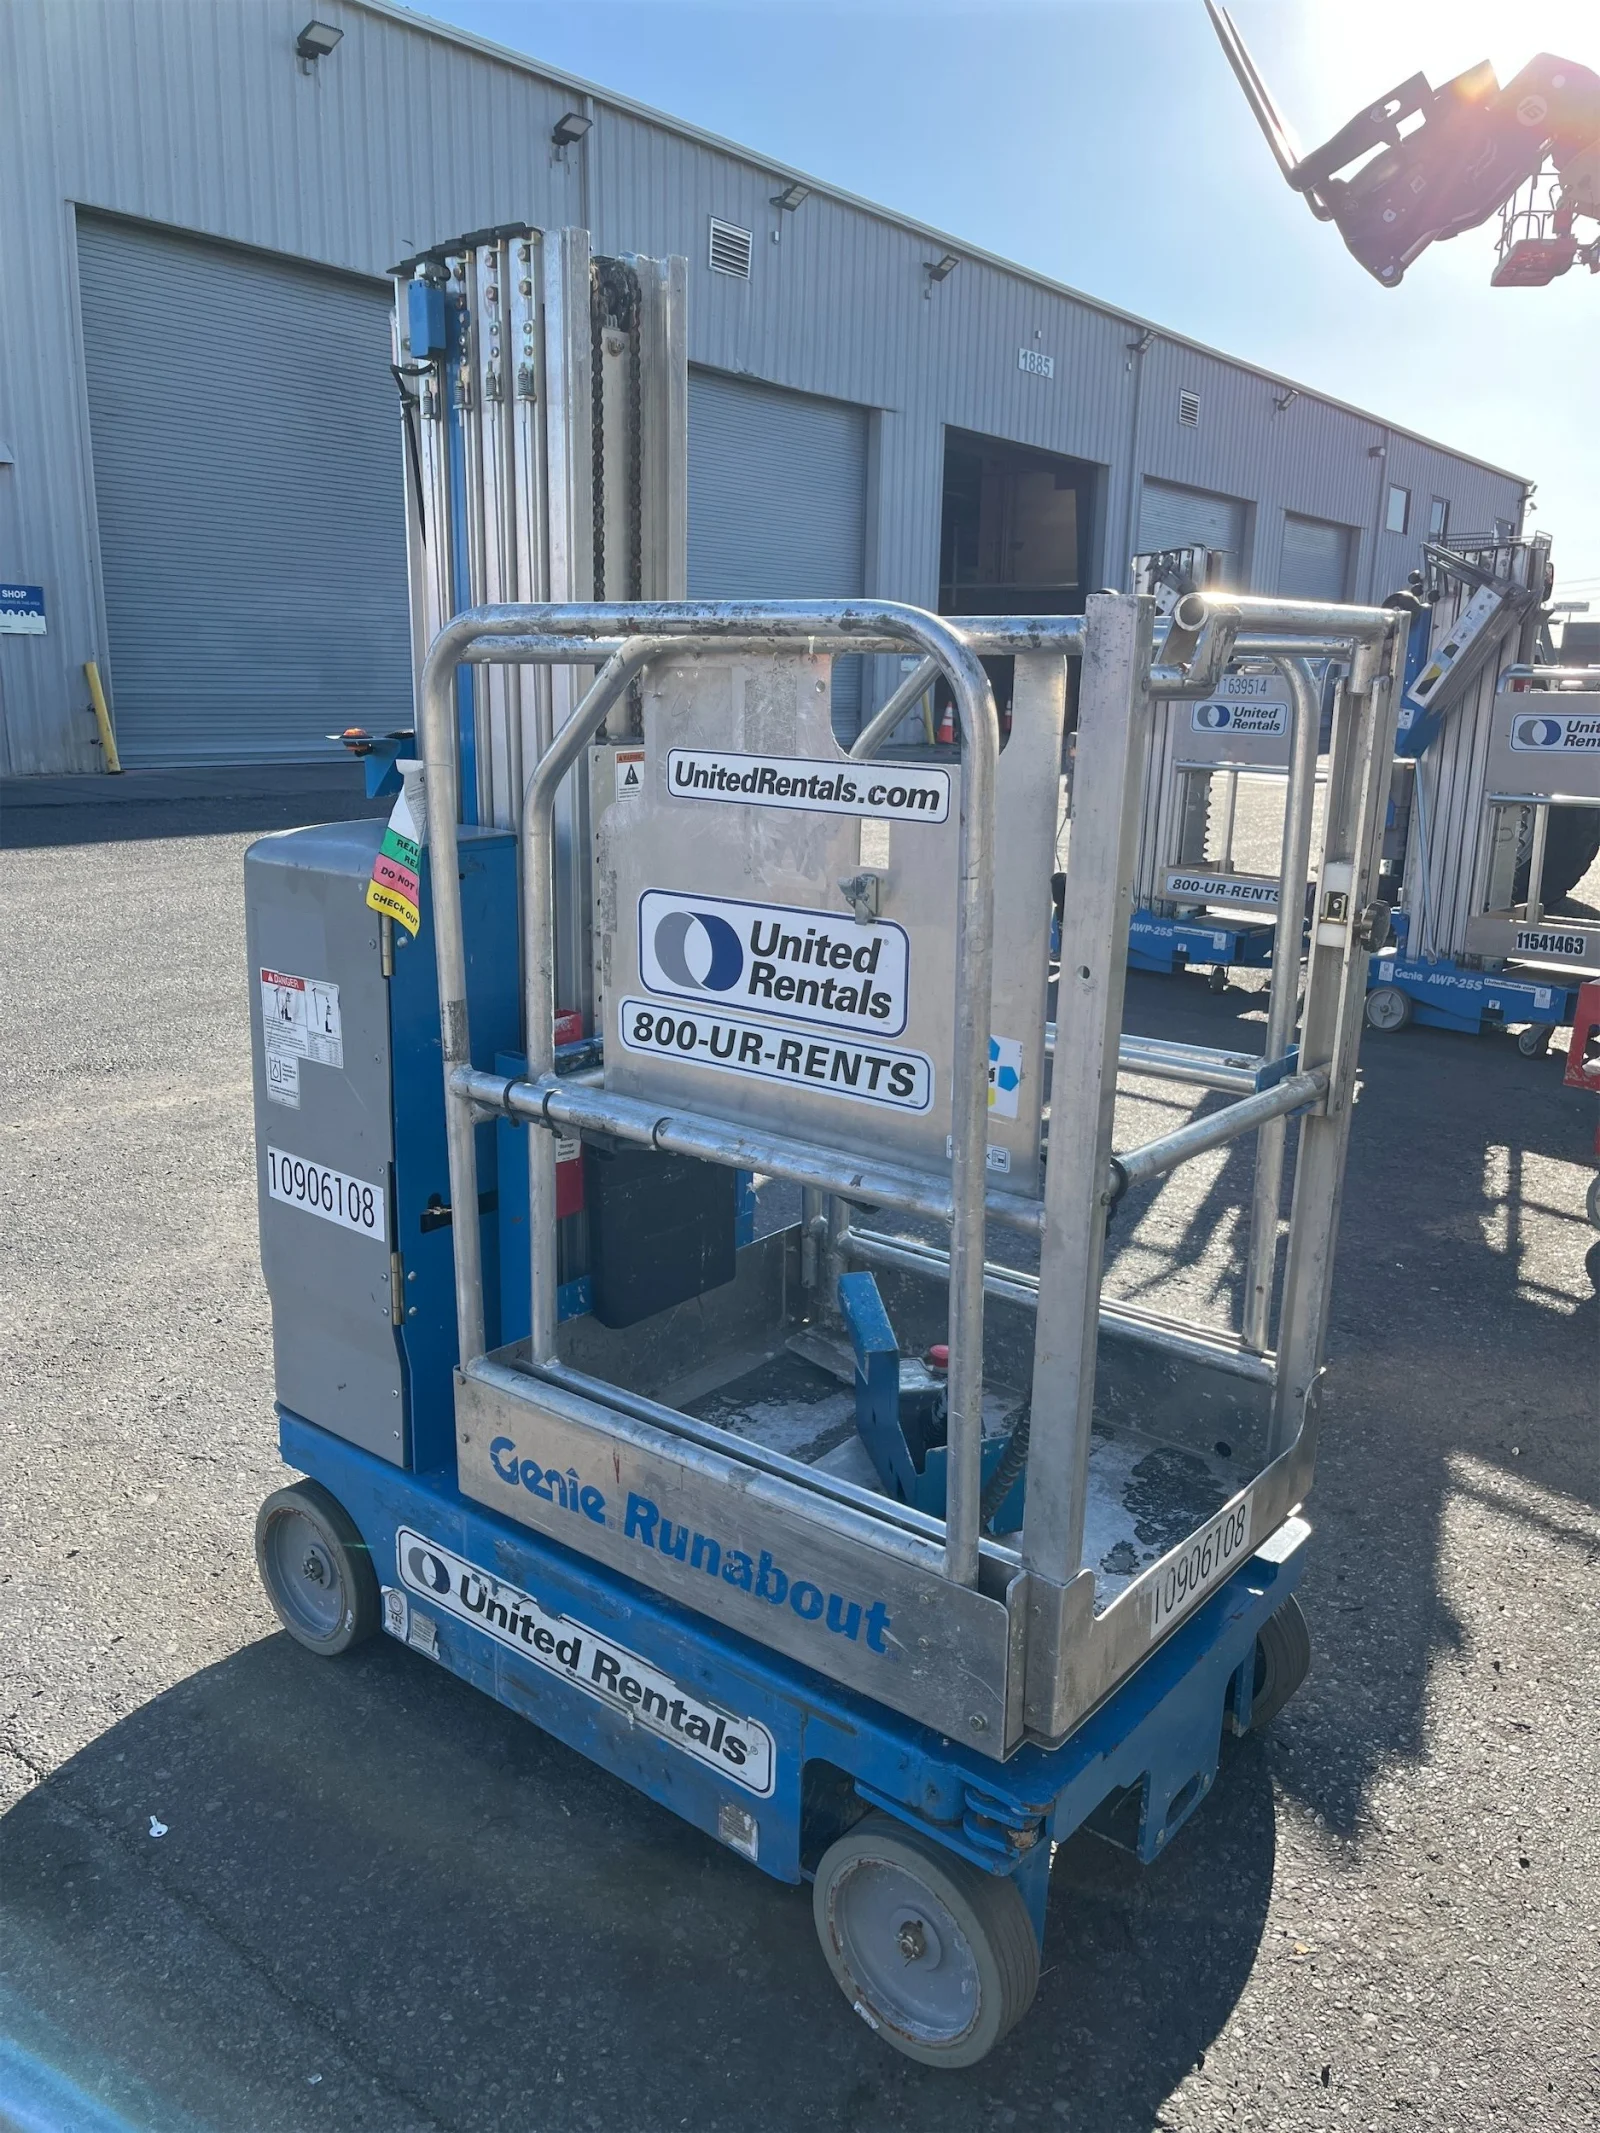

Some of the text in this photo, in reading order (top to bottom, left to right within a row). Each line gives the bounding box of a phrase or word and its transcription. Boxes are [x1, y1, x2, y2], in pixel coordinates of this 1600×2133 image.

[1021, 350, 1050, 377] 1885
[1, 589, 27, 599] SHOP
[1232, 718, 1281, 732] Rentals
[1234, 706, 1279, 719] United
[675, 760, 940, 811] UnitedRentals.com
[381, 866, 415, 890] DO NOT
[373, 892, 405, 914] CHECK
[1130, 922, 1173, 937] AWP-25S
[750, 920, 882, 974] United
[1517, 932, 1584, 955] 11541463
[274, 974, 299, 989] DANGER
[748, 961, 892, 1019] Rentals
[1395, 968, 1483, 991] Genie AWP-25S
[633, 1012, 916, 1097] 800-UR-RENTS
[269, 1152, 375, 1228] 10906108
[489, 1436, 892, 1655] Genie Runabout
[1154, 1504, 1246, 1625] 10906108
[460, 1574, 747, 1766] United Rentals
